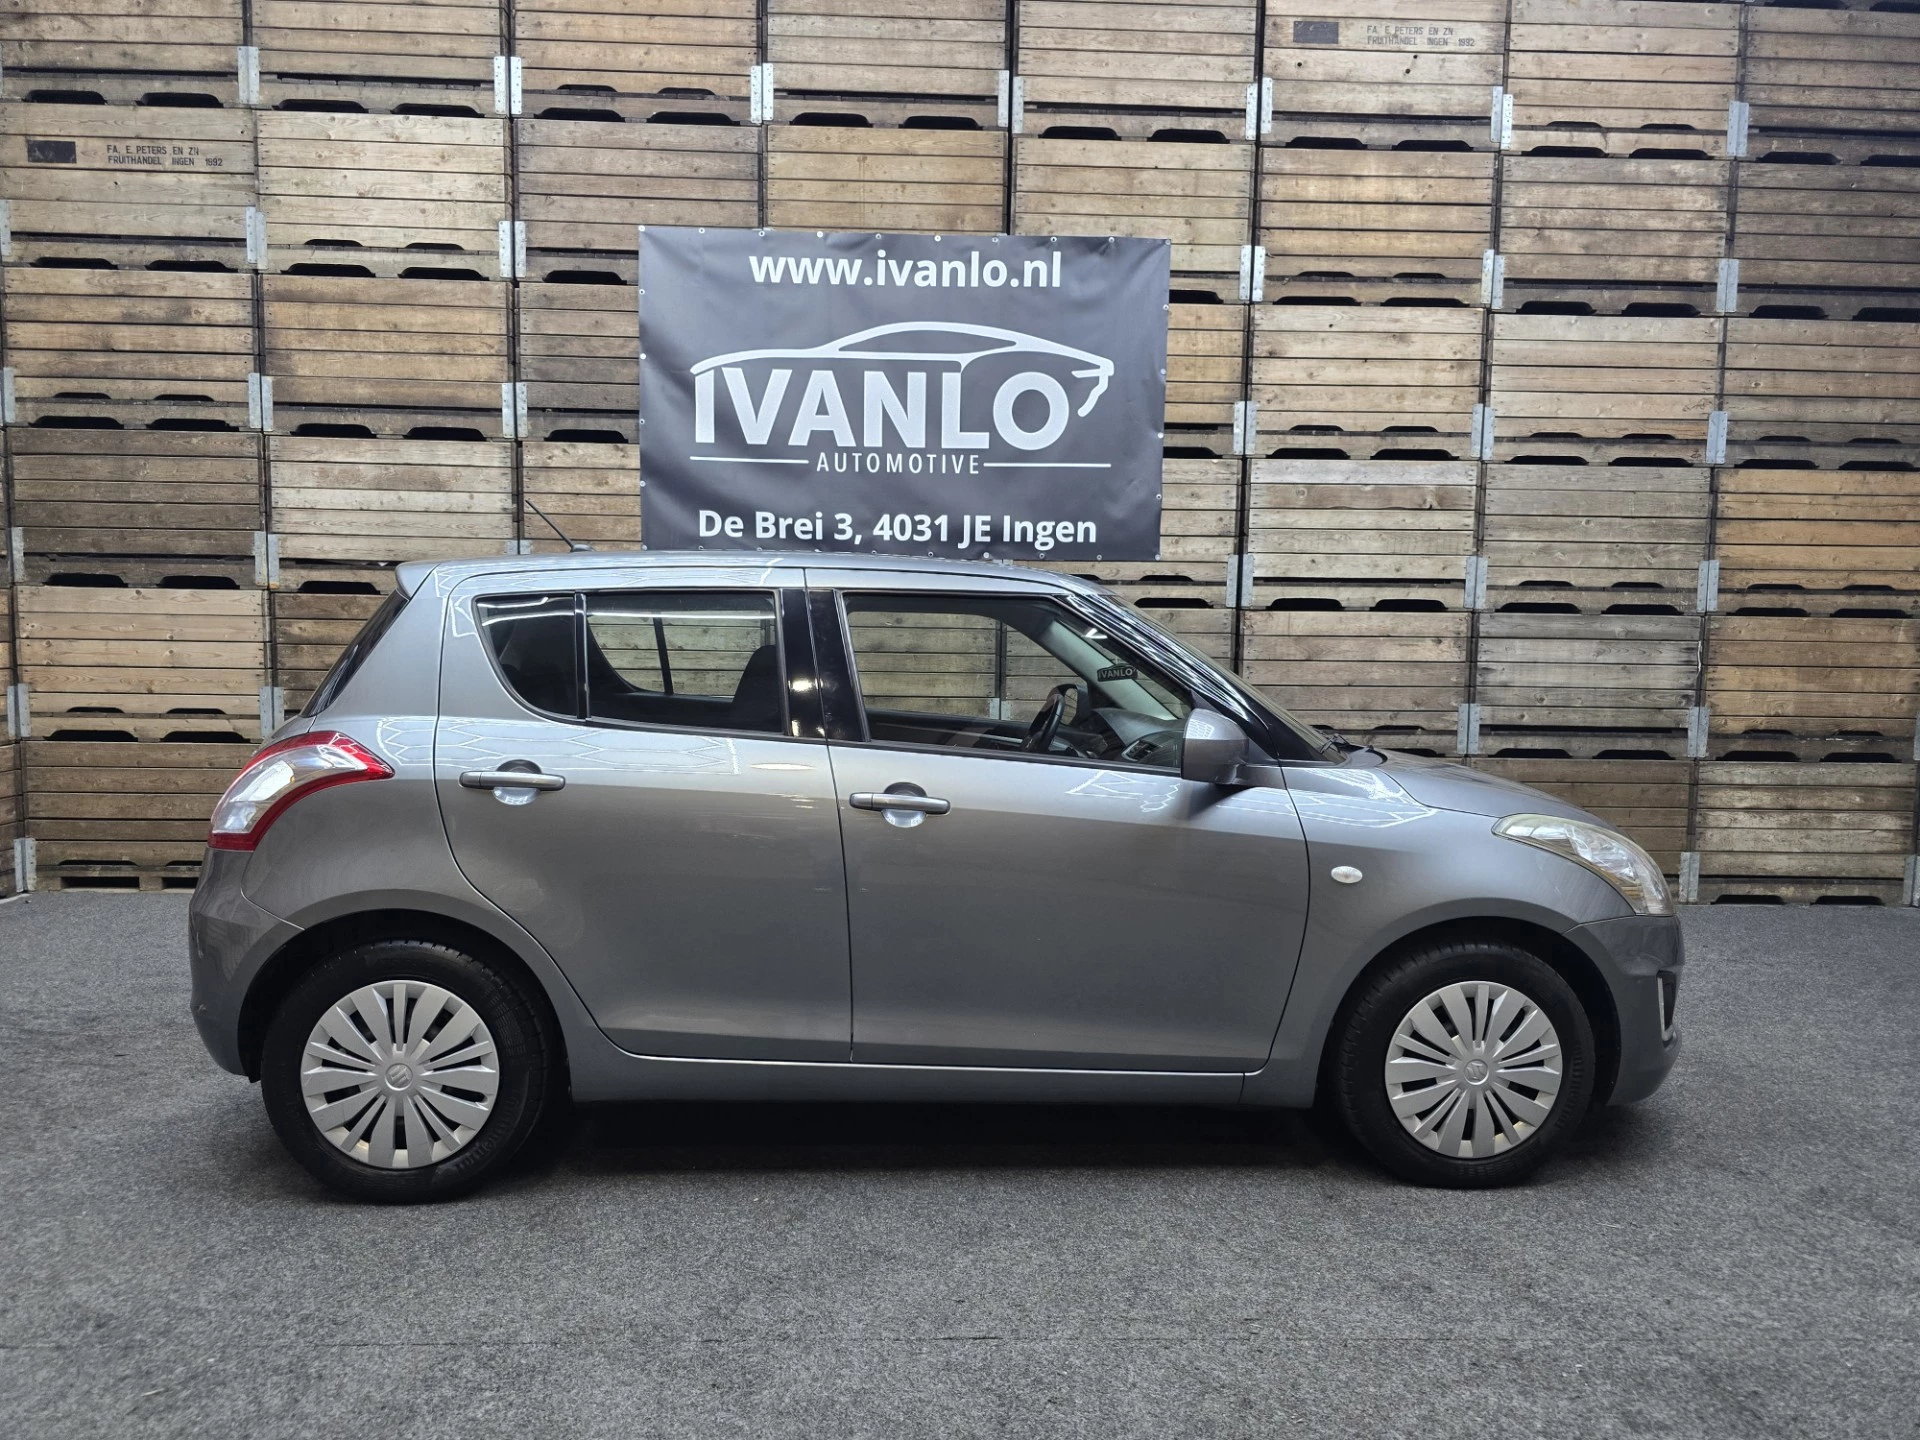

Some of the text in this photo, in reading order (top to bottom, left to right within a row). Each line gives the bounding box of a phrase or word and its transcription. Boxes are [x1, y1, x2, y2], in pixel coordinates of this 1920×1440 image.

[1394, 26, 1424, 35] PETERS
[1428, 27, 1439, 36] EN
[1443, 27, 1454, 36] ZN
[1367, 35, 1475, 47] FRUITHANDEL INGEN 1992
[136, 146, 167, 155] PETERS
[173, 147, 184, 156] EN
[189, 147, 200, 156] ZN
[108, 156, 224, 167] FRUITHANDEL INGEN 1992
[748, 249, 1061, 288] www.ivanlo.nl
[694, 366, 1070, 451] IVANLO
[816, 452, 980, 475] AUTOMOTIVE
[698, 510, 1097, 551] De Brei 3, 4031 JE Ingen
